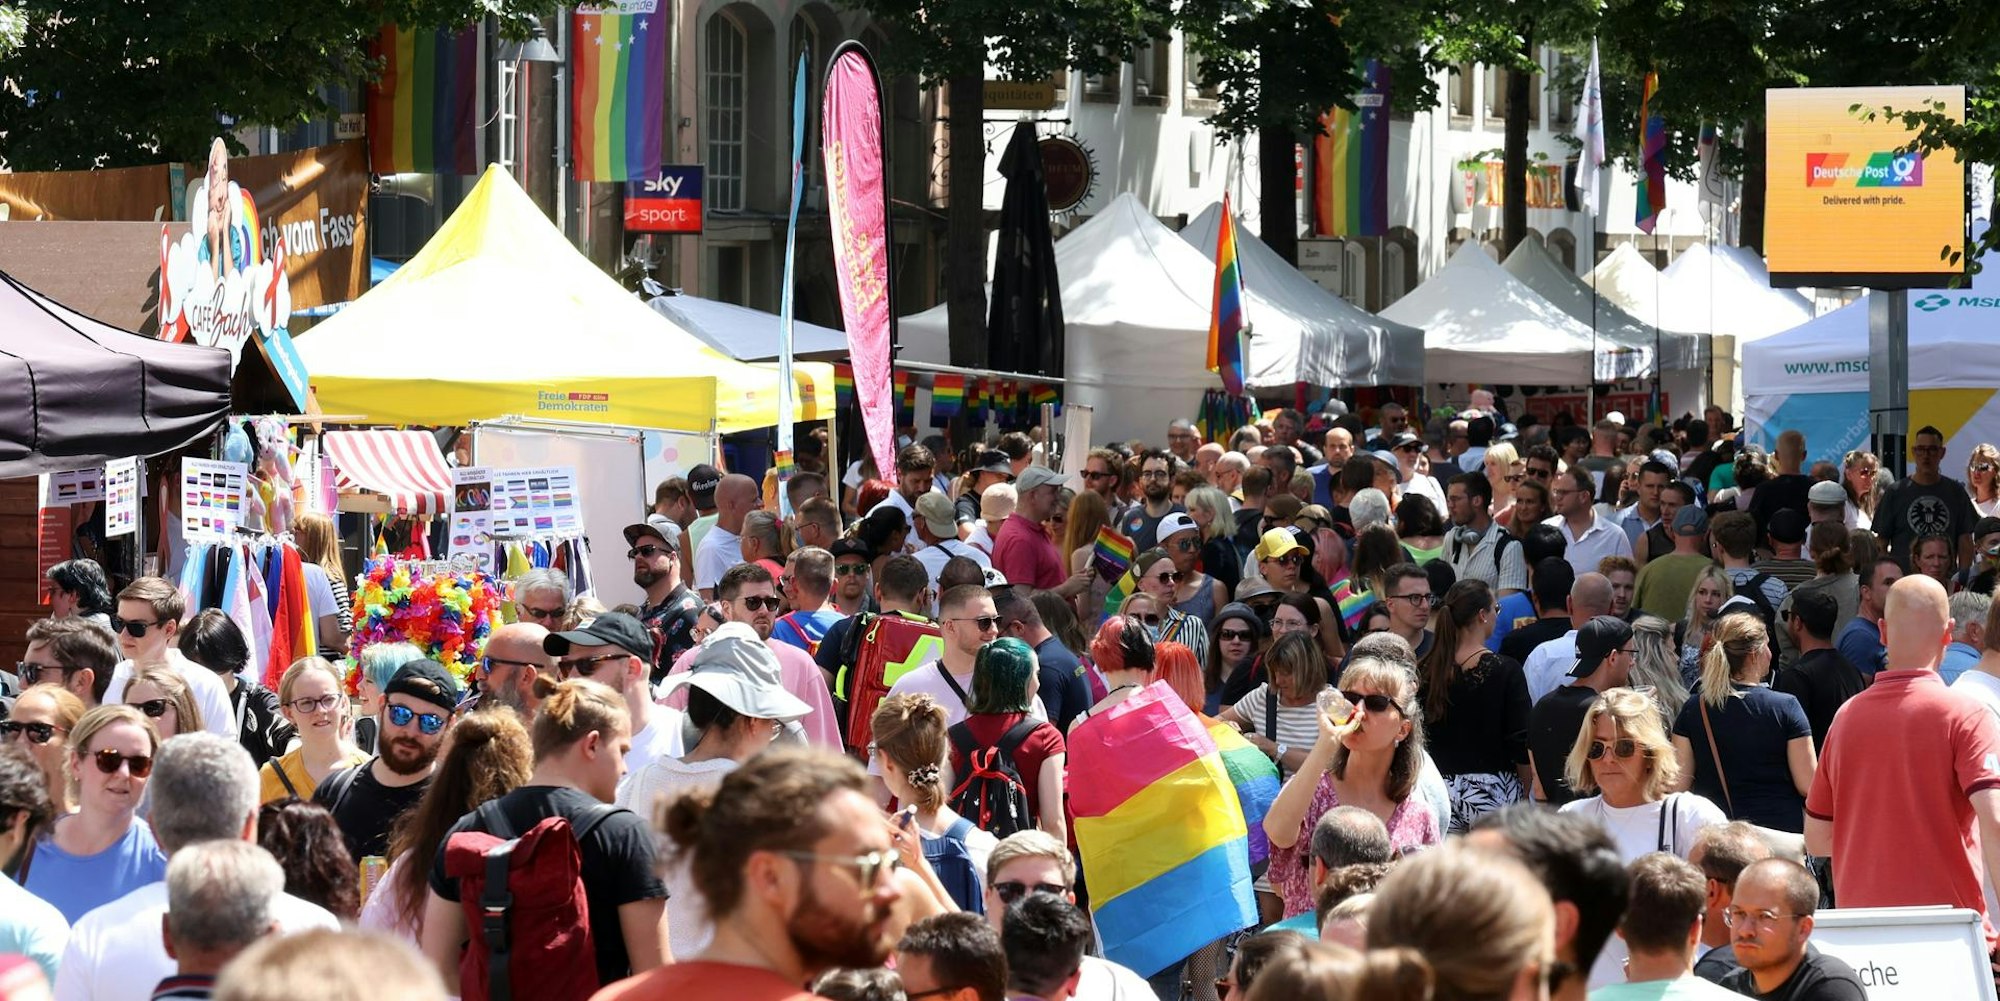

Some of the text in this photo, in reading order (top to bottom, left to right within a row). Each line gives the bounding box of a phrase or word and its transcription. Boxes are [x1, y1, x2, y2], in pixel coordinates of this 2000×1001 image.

[984, 88, 1043, 103] iquitäten
[1813, 166, 1889, 178] Deutsche Post
[643, 171, 684, 197] sky
[1823, 195, 1906, 206] Delivered with pride.
[639, 208, 686, 224] sport
[282, 219, 319, 256] vom
[319, 207, 355, 249] Fass
[192, 301, 212, 332] CAFÉ
[210, 282, 250, 347] Bach
[1784, 356, 1870, 374] www.msd
[538, 391, 566, 401] Freie
[538, 401, 608, 412] Demokraten
[1853, 960, 1899, 987] che
